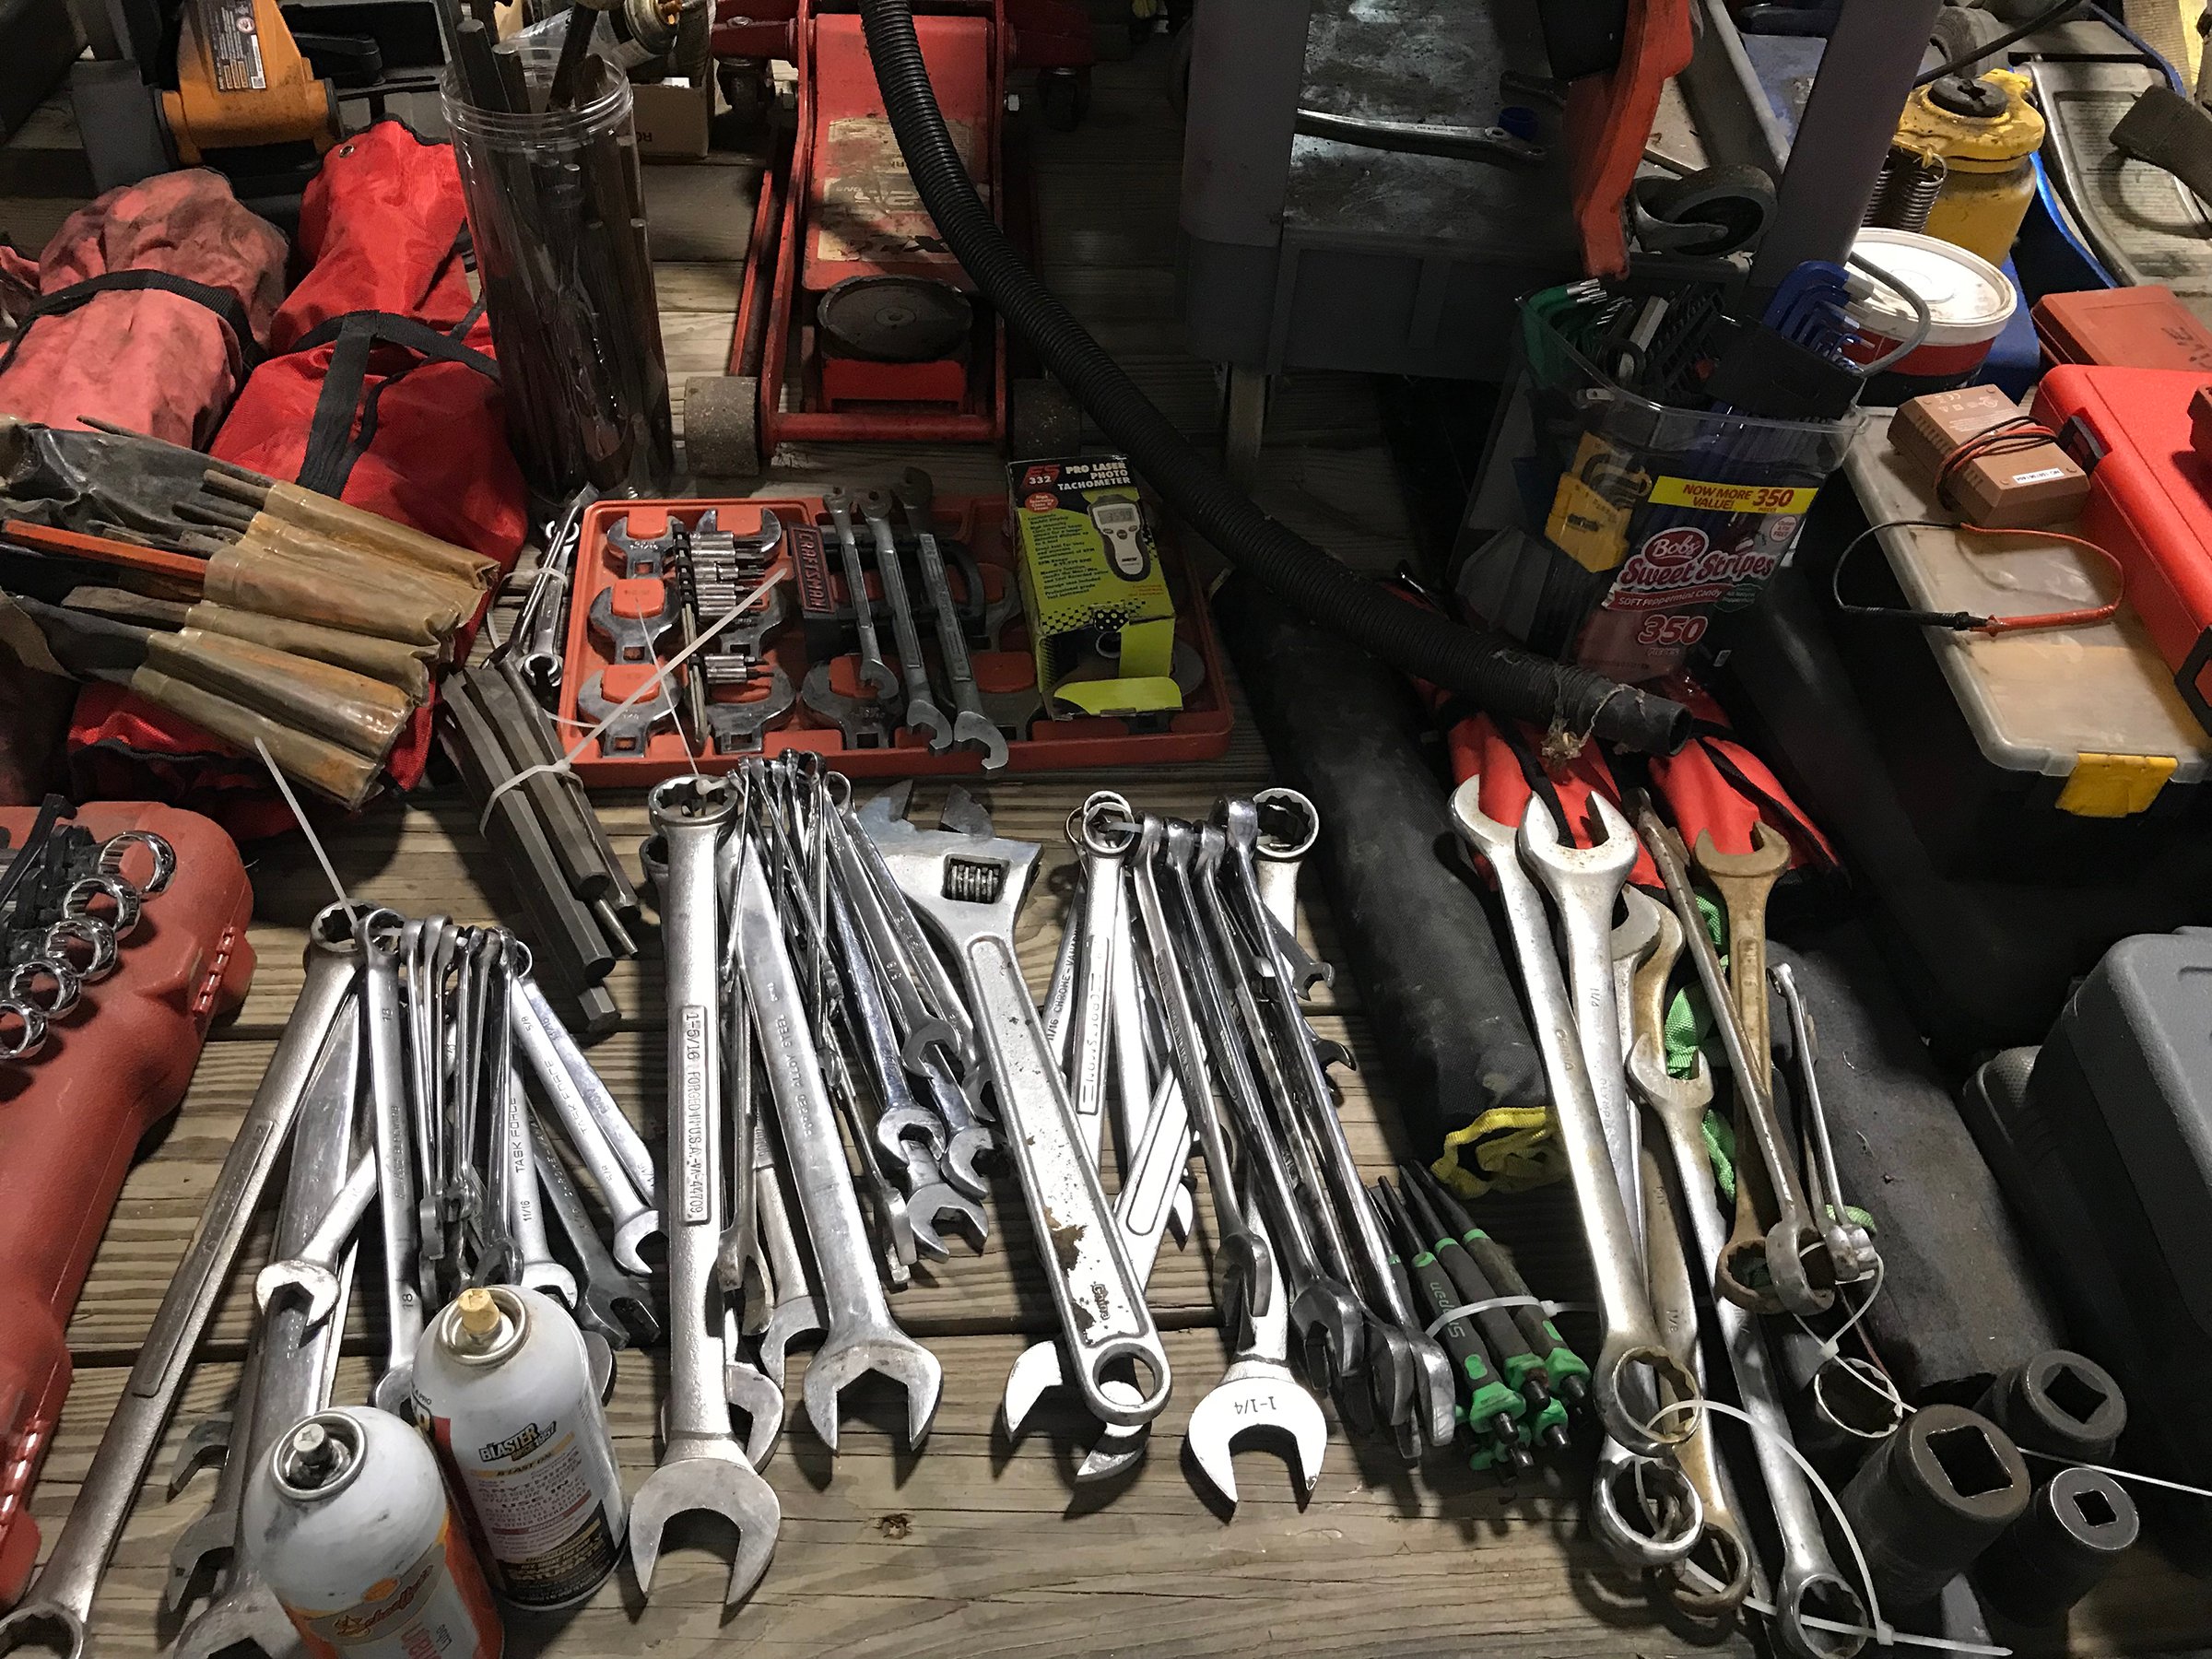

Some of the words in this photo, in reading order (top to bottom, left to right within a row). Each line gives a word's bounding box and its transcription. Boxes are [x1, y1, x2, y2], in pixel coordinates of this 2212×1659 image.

[1065, 464, 1089, 475] PRO
[1091, 462, 1126, 471] LASER
[1089, 469, 1128, 479] PHOTO
[1029, 475, 1052, 485] 332
[1057, 477, 1131, 491] TACHOMETER
[1683, 484, 1716, 496] NOW
[1715, 488, 1753, 500] MORE
[1752, 488, 1794, 508] 350
[1692, 497, 1735, 510] VALUE!
[1653, 535, 1700, 558] Bobs
[799, 533, 826, 608] CRAFTSMAN
[1619, 558, 1696, 585] Sweet
[1697, 551, 1775, 582] Stripes
[1618, 596, 1641, 606] SOFT
[1642, 591, 1694, 607] Peppermint
[1695, 587, 1723, 600] Candy
[1638, 614, 1709, 645] 350
[382, 1006, 394, 1022] 18
[686, 1013, 700, 1061] 1-5/16
[688, 1071, 701, 1112] FORGED
[567, 1103, 587, 1135] TASK
[514, 1140, 524, 1174] TASK
[522, 1200, 532, 1222] 11/16
[403, 1292, 413, 1310] 18
[1234, 1395, 1277, 1415] 1-1/4
